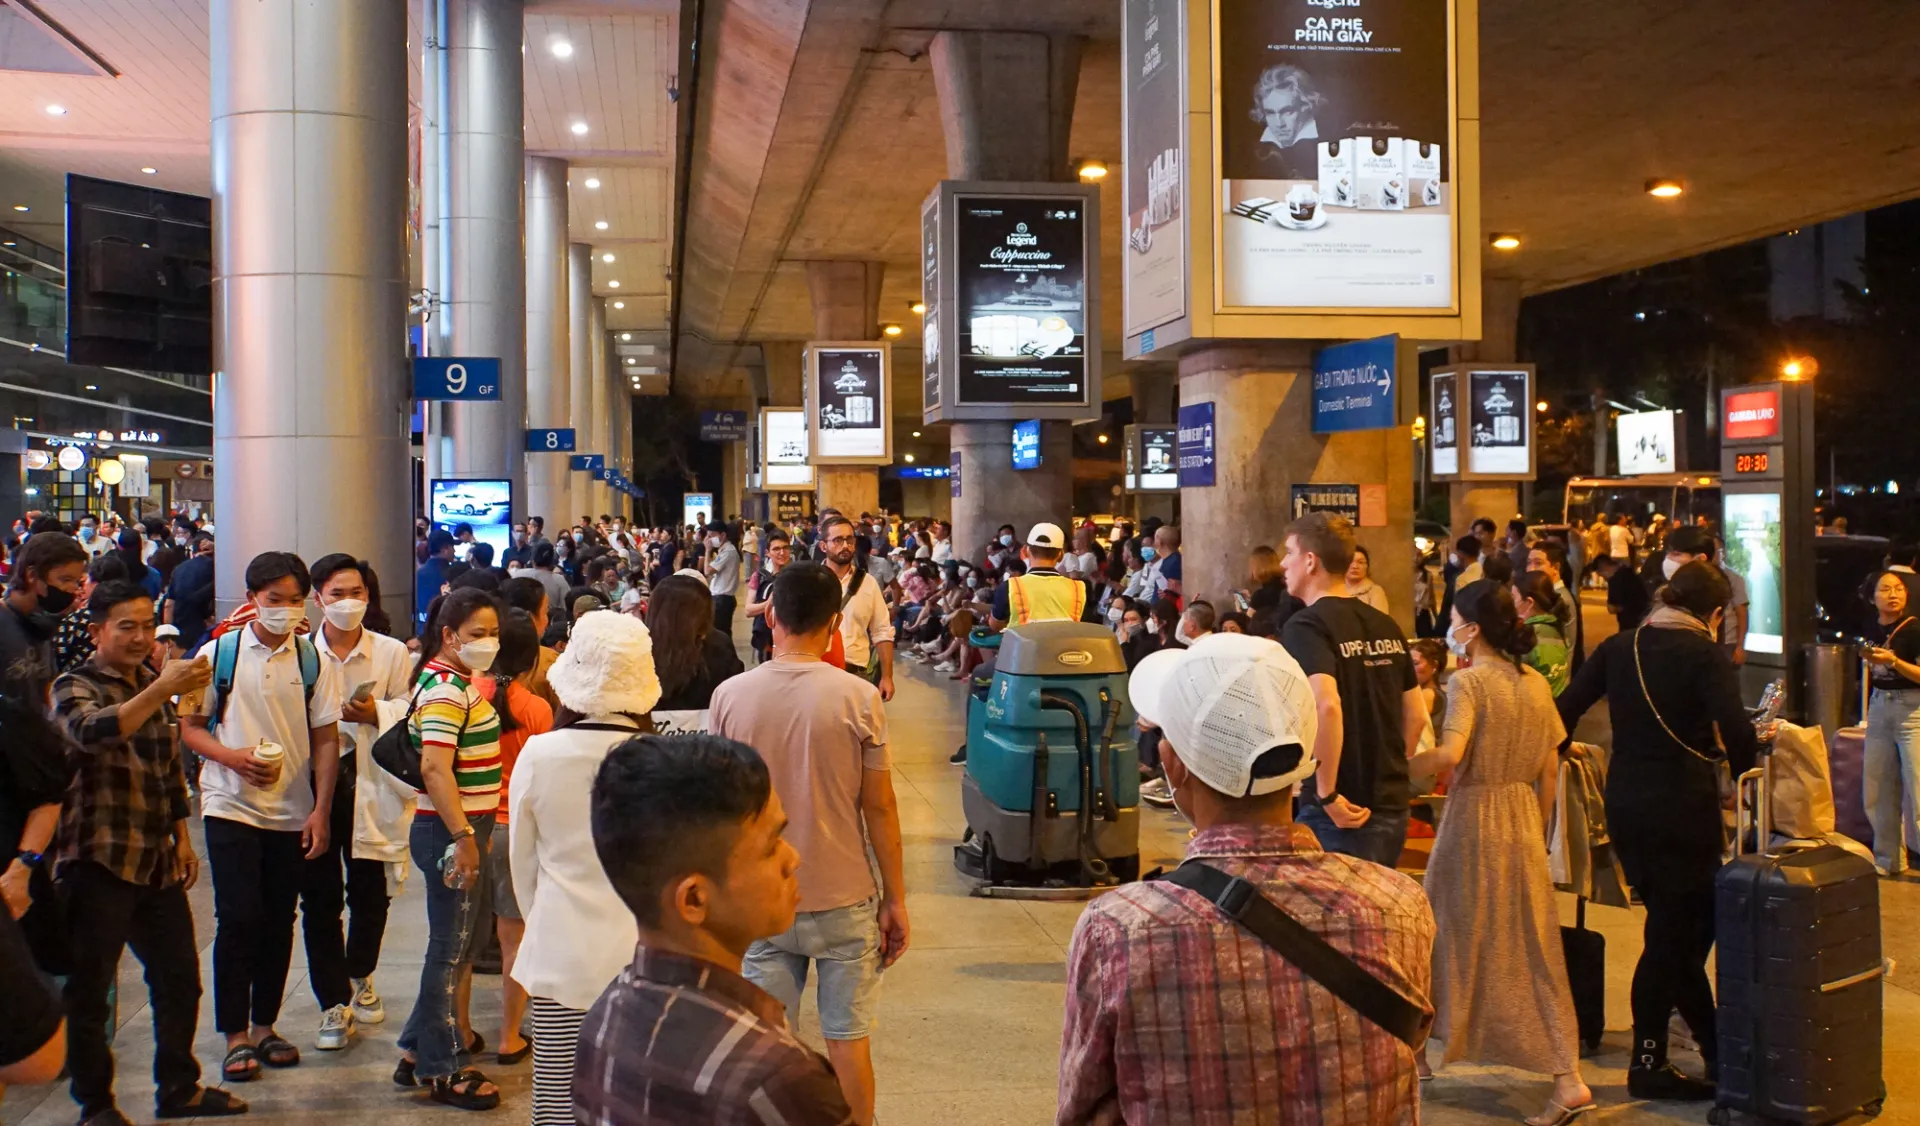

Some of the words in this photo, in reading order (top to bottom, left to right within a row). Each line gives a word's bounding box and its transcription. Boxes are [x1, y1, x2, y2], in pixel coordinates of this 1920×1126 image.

[1295, 29, 1333, 42] PHIN
[1007, 235, 1037, 246] Legend
[990, 246, 1052, 263] Cappuccino
[446, 363, 467, 394] 9
[478, 385, 494, 395] GF
[1332, 368, 1355, 386] TRONG
[1319, 397, 1345, 412] Domestic
[1346, 393, 1372, 409] Terminal
[1729, 409, 1756, 422] GAMUDA
[1757, 408, 1775, 420] LAND
[546, 432, 558, 448] 8
[584, 457, 592, 468] 7
[1737, 455, 1768, 472] 20:30
[604, 470, 610, 479] 6
[1339, 641, 1363, 658] UPP
